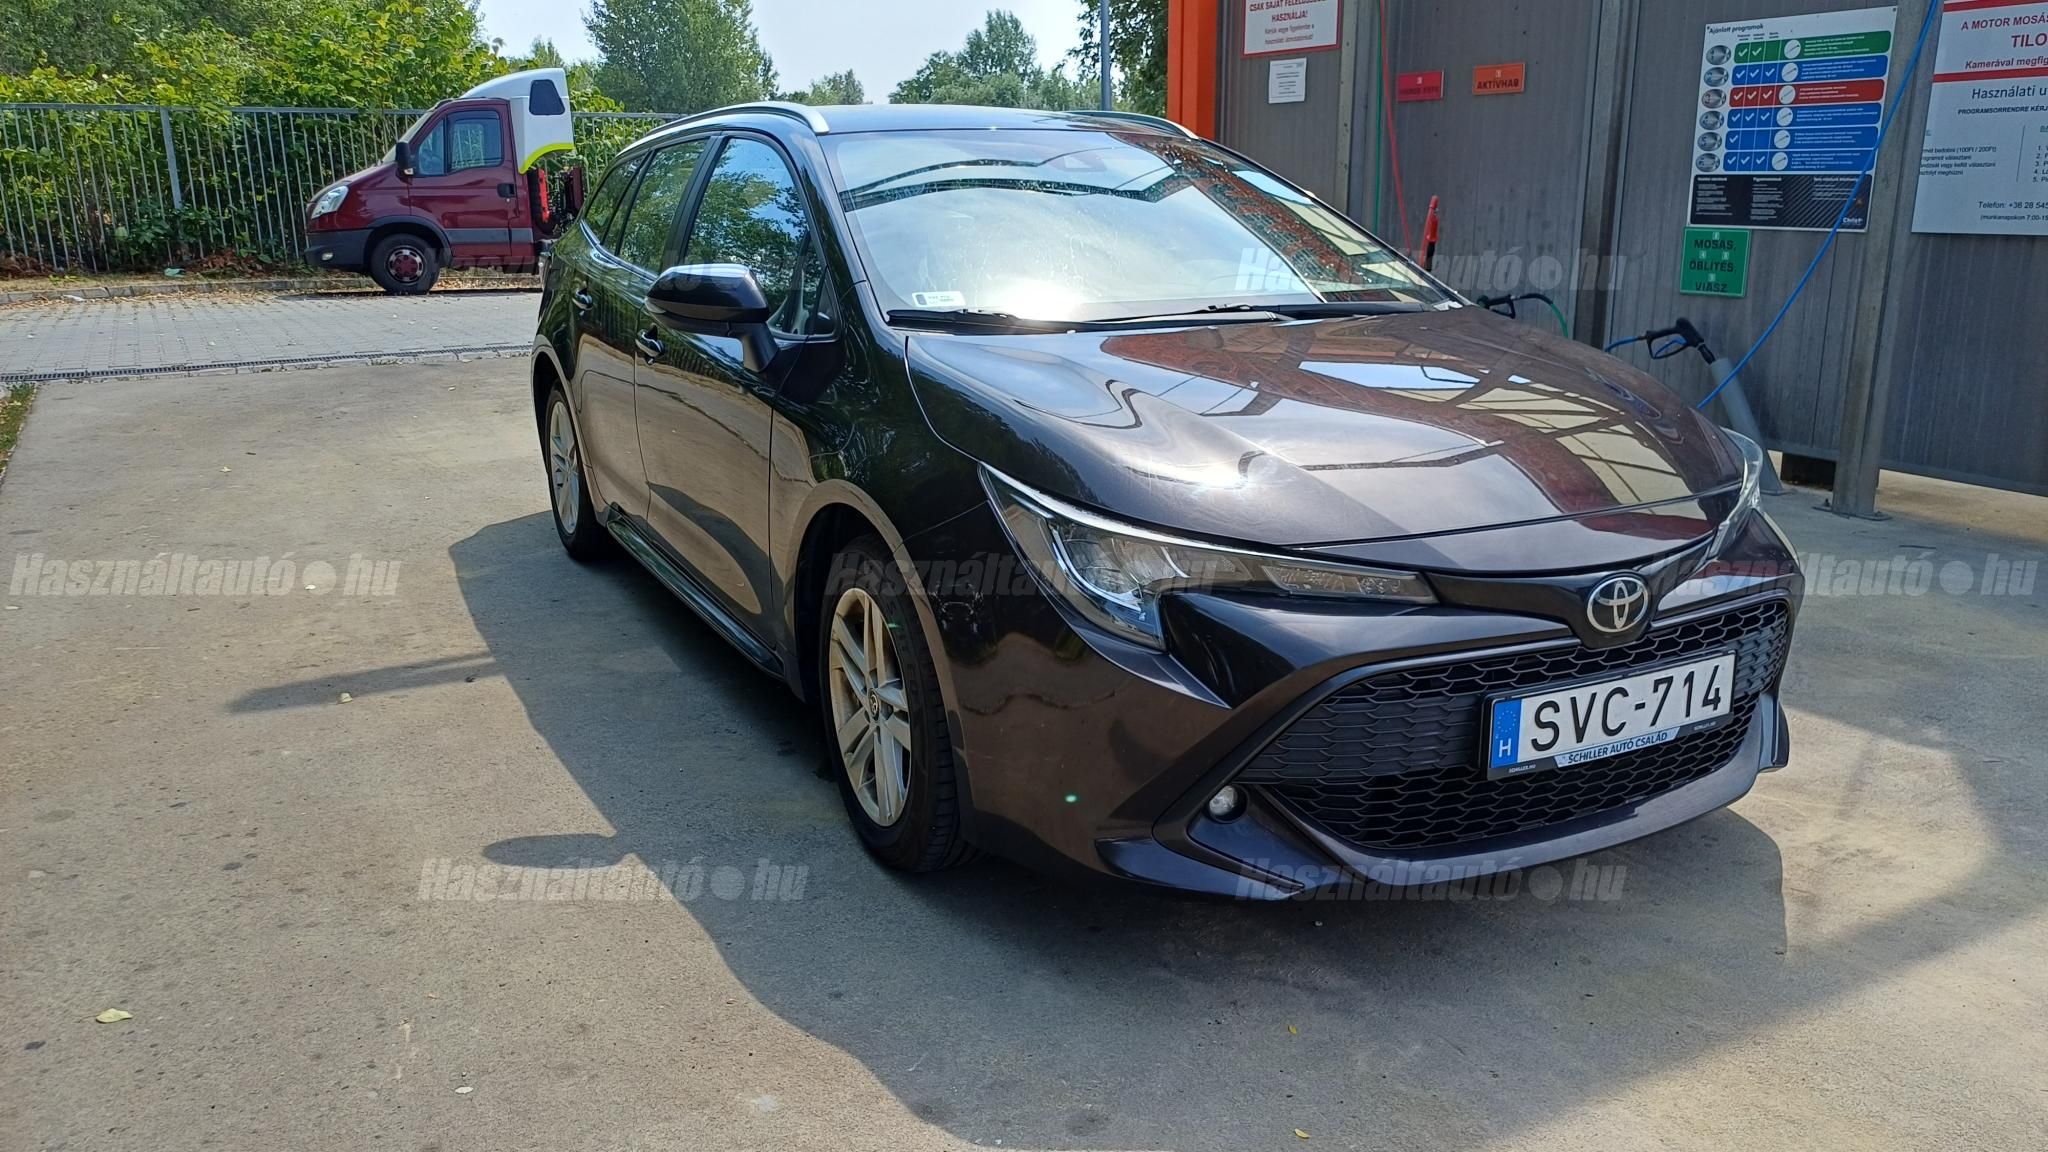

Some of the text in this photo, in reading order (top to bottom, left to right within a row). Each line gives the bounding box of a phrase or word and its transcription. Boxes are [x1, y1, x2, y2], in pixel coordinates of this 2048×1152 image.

[1961, 22, 1969, 31] A
[1971, 18, 2010, 30] MOTOR
[2011, 33, 2048, 48] TILO
[1965, 58, 2014, 69] Kamerával
[1971, 85, 2036, 99] Használati
[1958, 105, 2029, 115] PROGRAMSORRENDRE
[1979, 201, 2006, 209] Telefon:
[1695, 281, 1728, 293] VIASZ
[1531, 664, 1722, 752] SVC-714
[1498, 738, 1512, 758] H
[1567, 732, 1668, 764] SCHILLER AUTÓ CSALÁD
